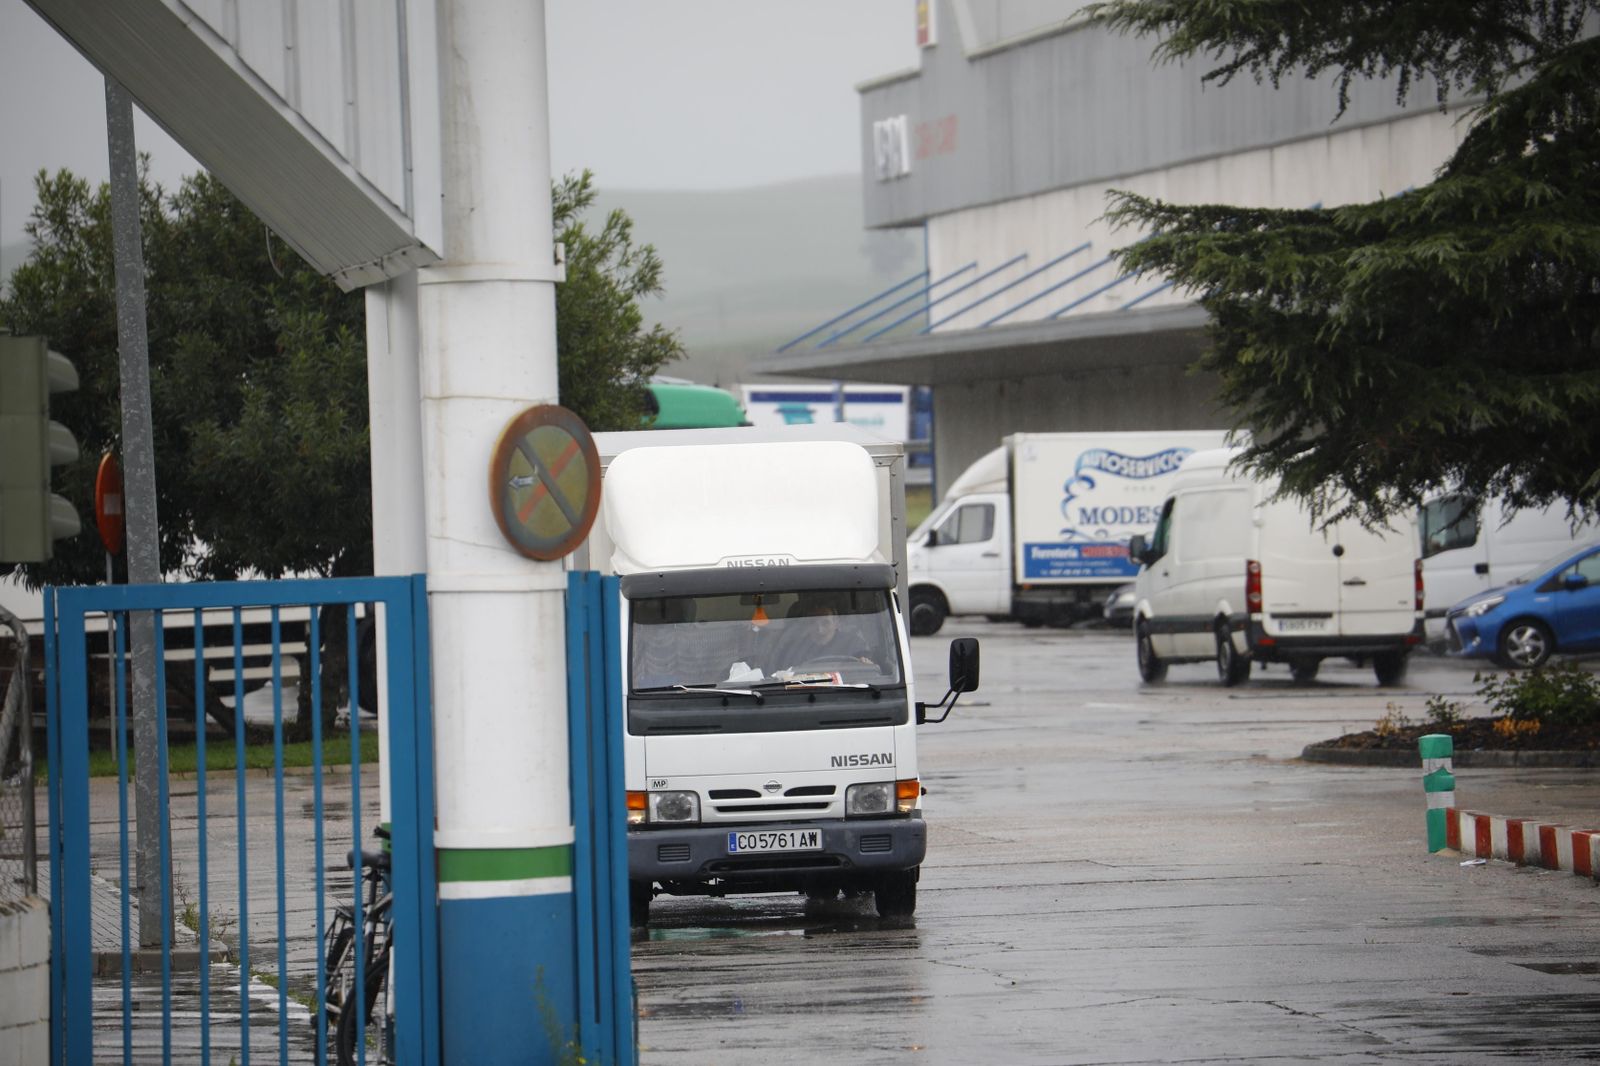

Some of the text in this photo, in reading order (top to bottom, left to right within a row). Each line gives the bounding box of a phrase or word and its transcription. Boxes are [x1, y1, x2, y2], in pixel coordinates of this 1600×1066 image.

[727, 558, 789, 568] NISSAN
[831, 753, 892, 767] NISSAN
[653, 780, 666, 788] MP
